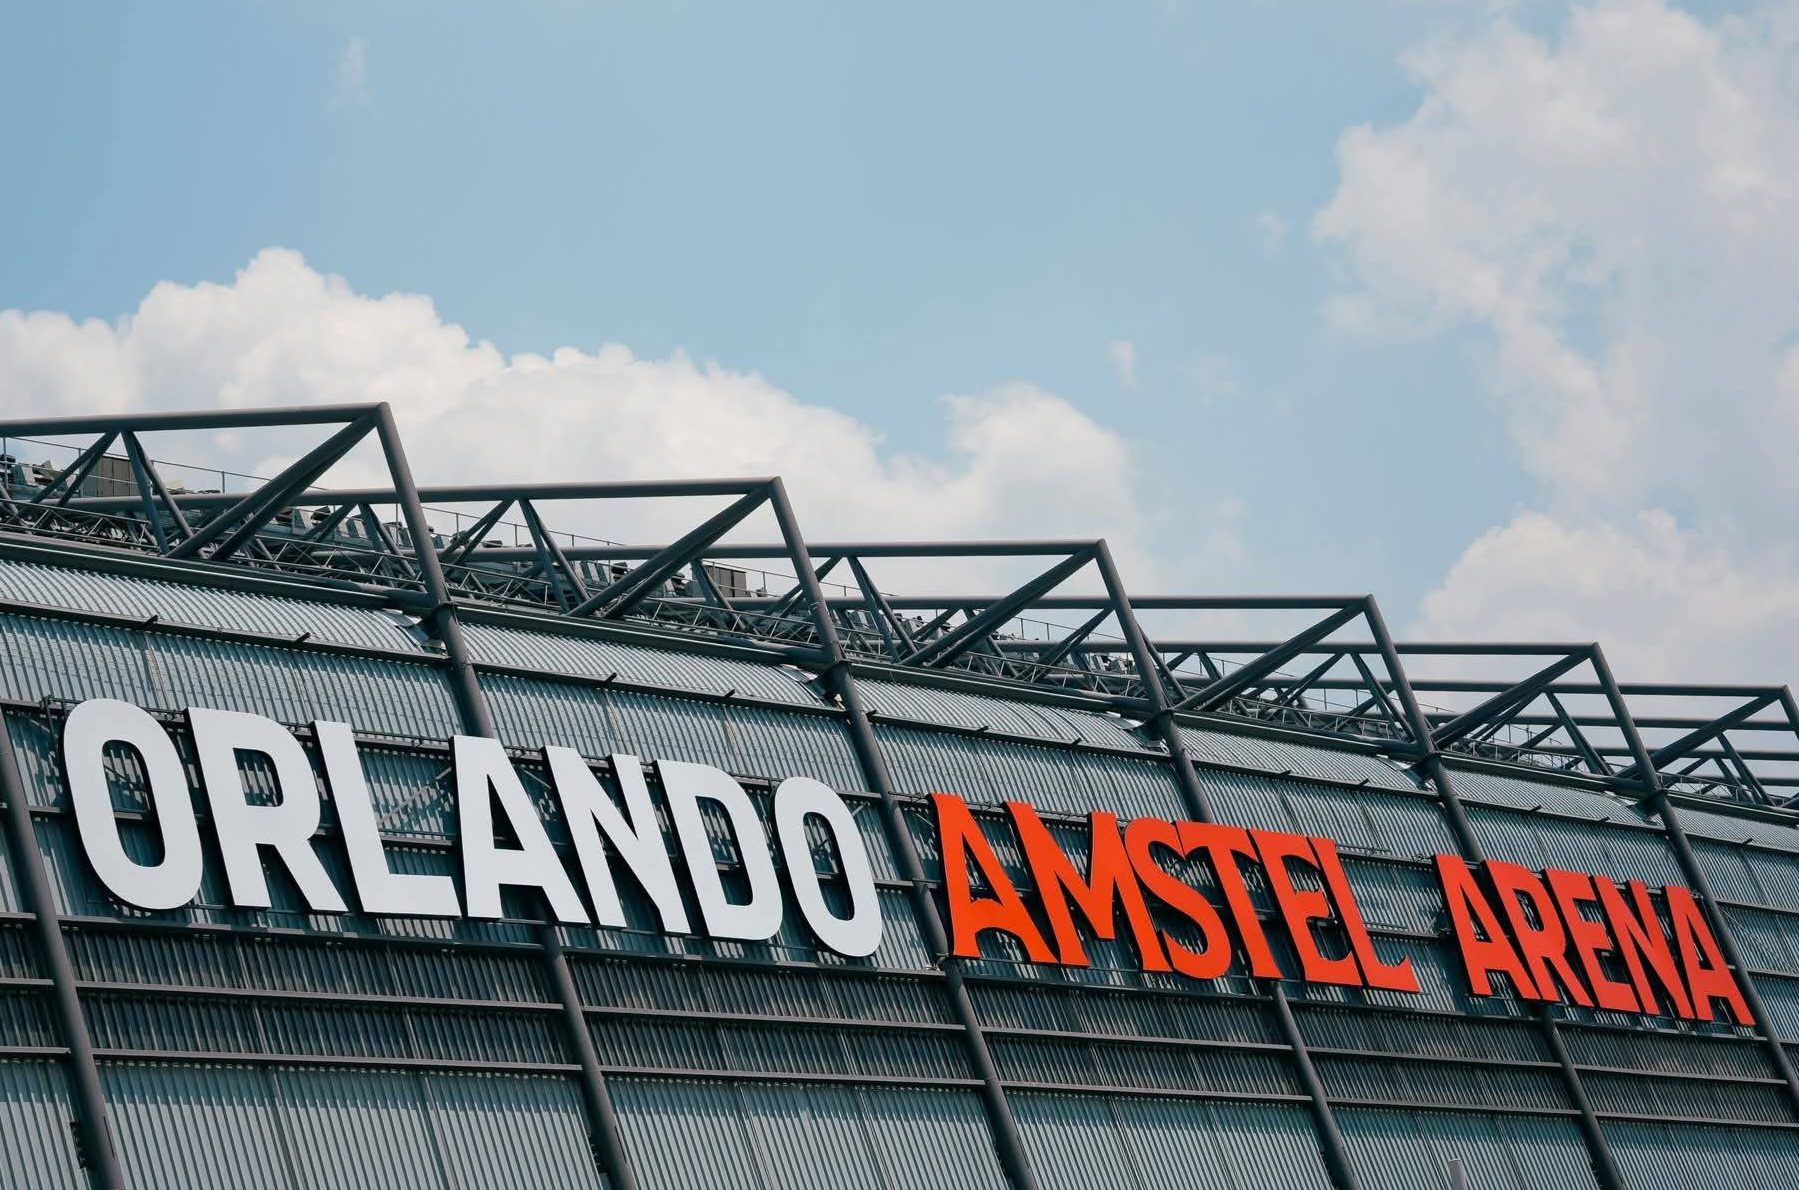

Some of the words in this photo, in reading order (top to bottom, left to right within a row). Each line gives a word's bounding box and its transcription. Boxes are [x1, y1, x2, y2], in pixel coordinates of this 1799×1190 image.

[63, 698, 883, 957] ORLANDO
[930, 792, 1420, 993] AMSTEL
[1436, 853, 1755, 1026] ARENA
